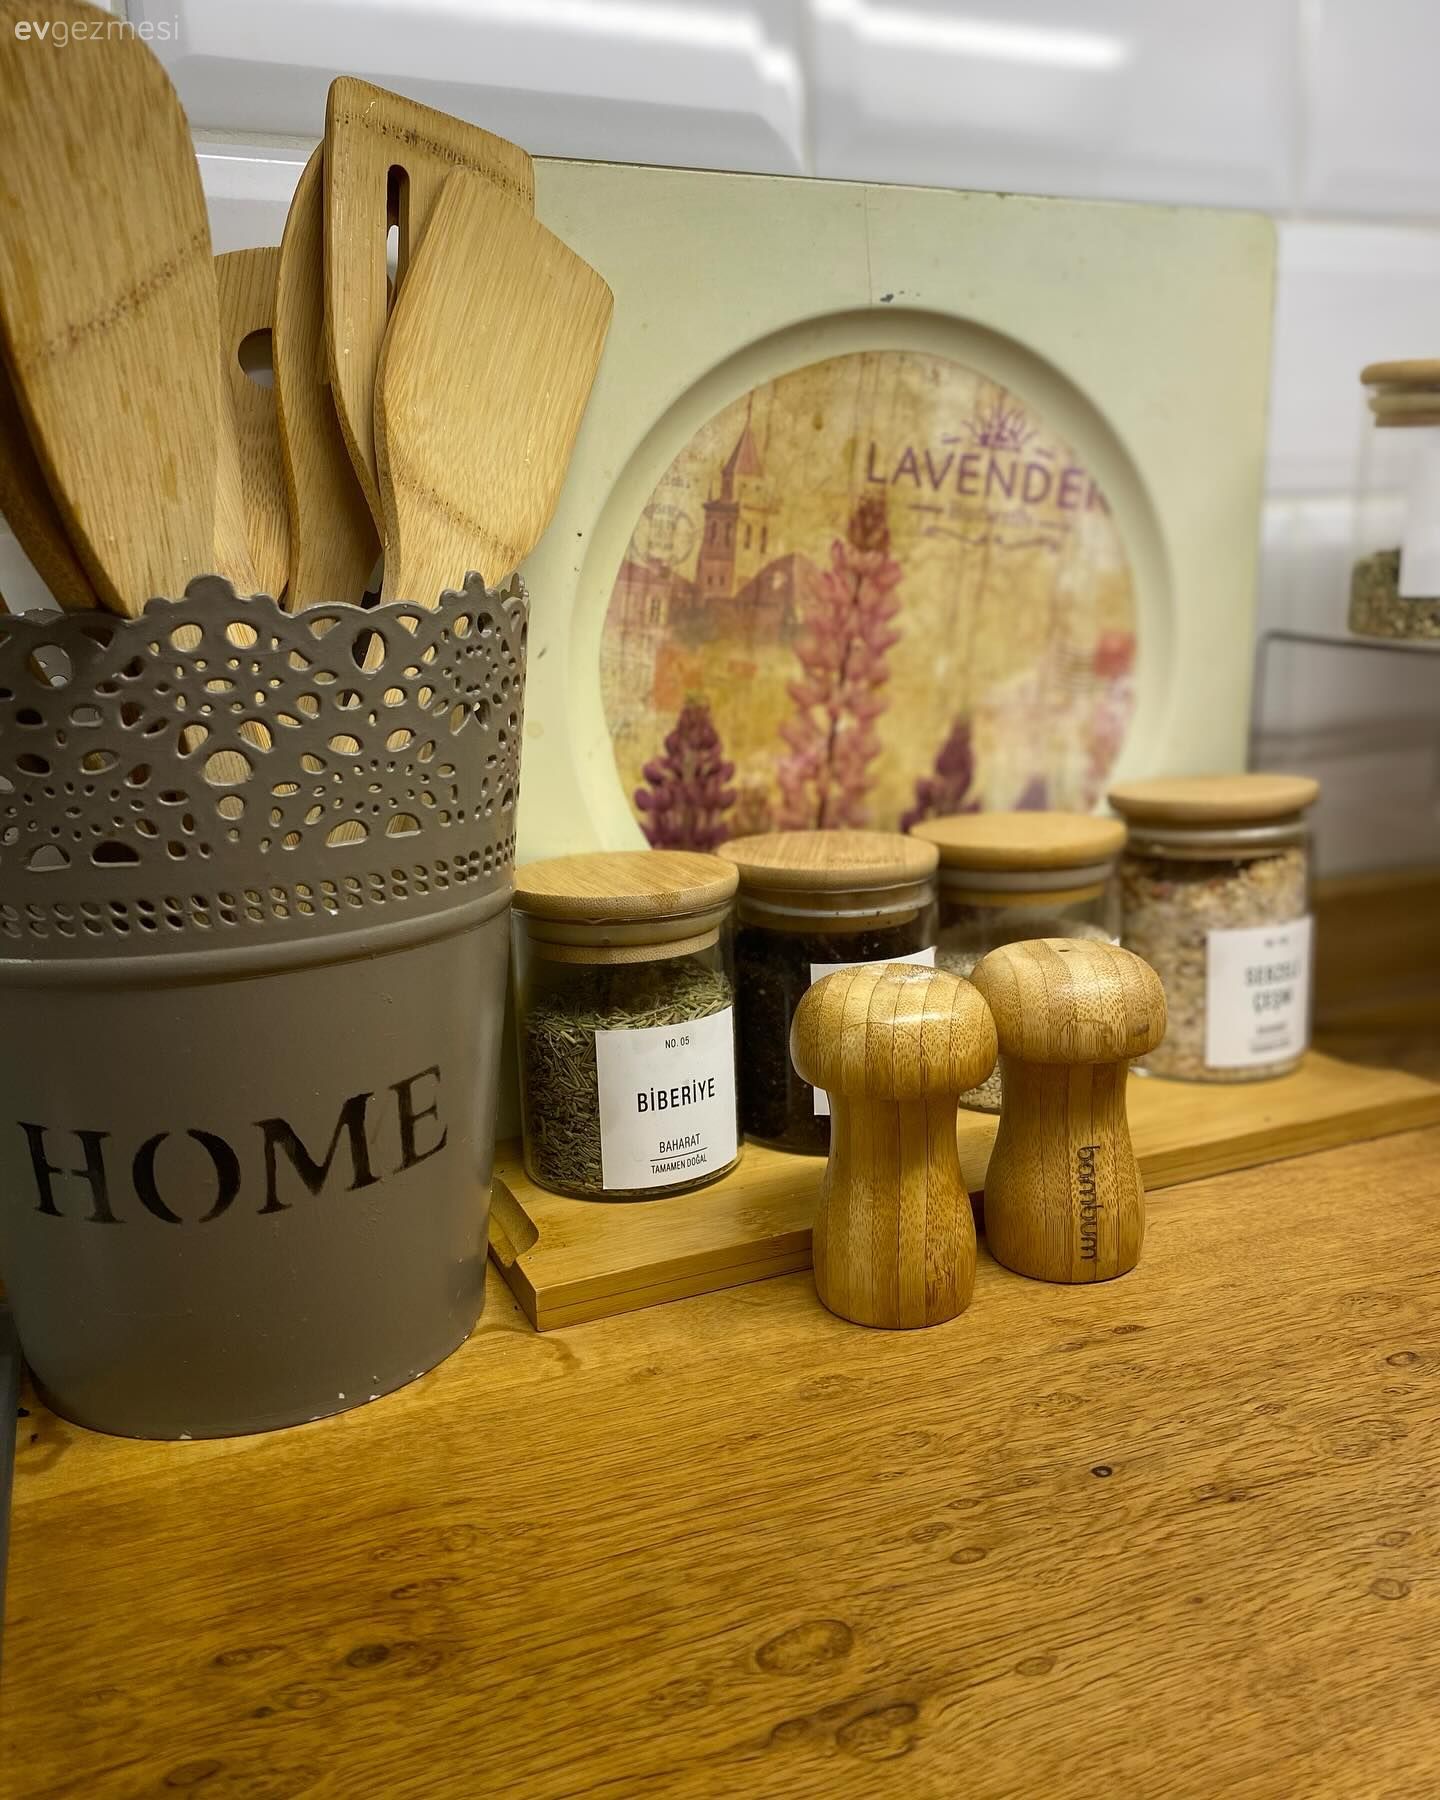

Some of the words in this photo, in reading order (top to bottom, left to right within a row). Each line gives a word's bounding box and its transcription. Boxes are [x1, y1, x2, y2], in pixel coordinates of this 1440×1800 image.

[665, 1038, 679, 1049] NO.
[680, 1036, 690, 1047] 05
[637, 1077, 716, 1113] BİBERİYE
[17, 1065, 448, 1225] HOME
[659, 1133, 701, 1154] BAHARAT
[651, 1160, 686, 1175] TAMAMEN
[686, 1153, 707, 1168] DOĞAL
[1077, 1145, 1104, 1260] bambum
